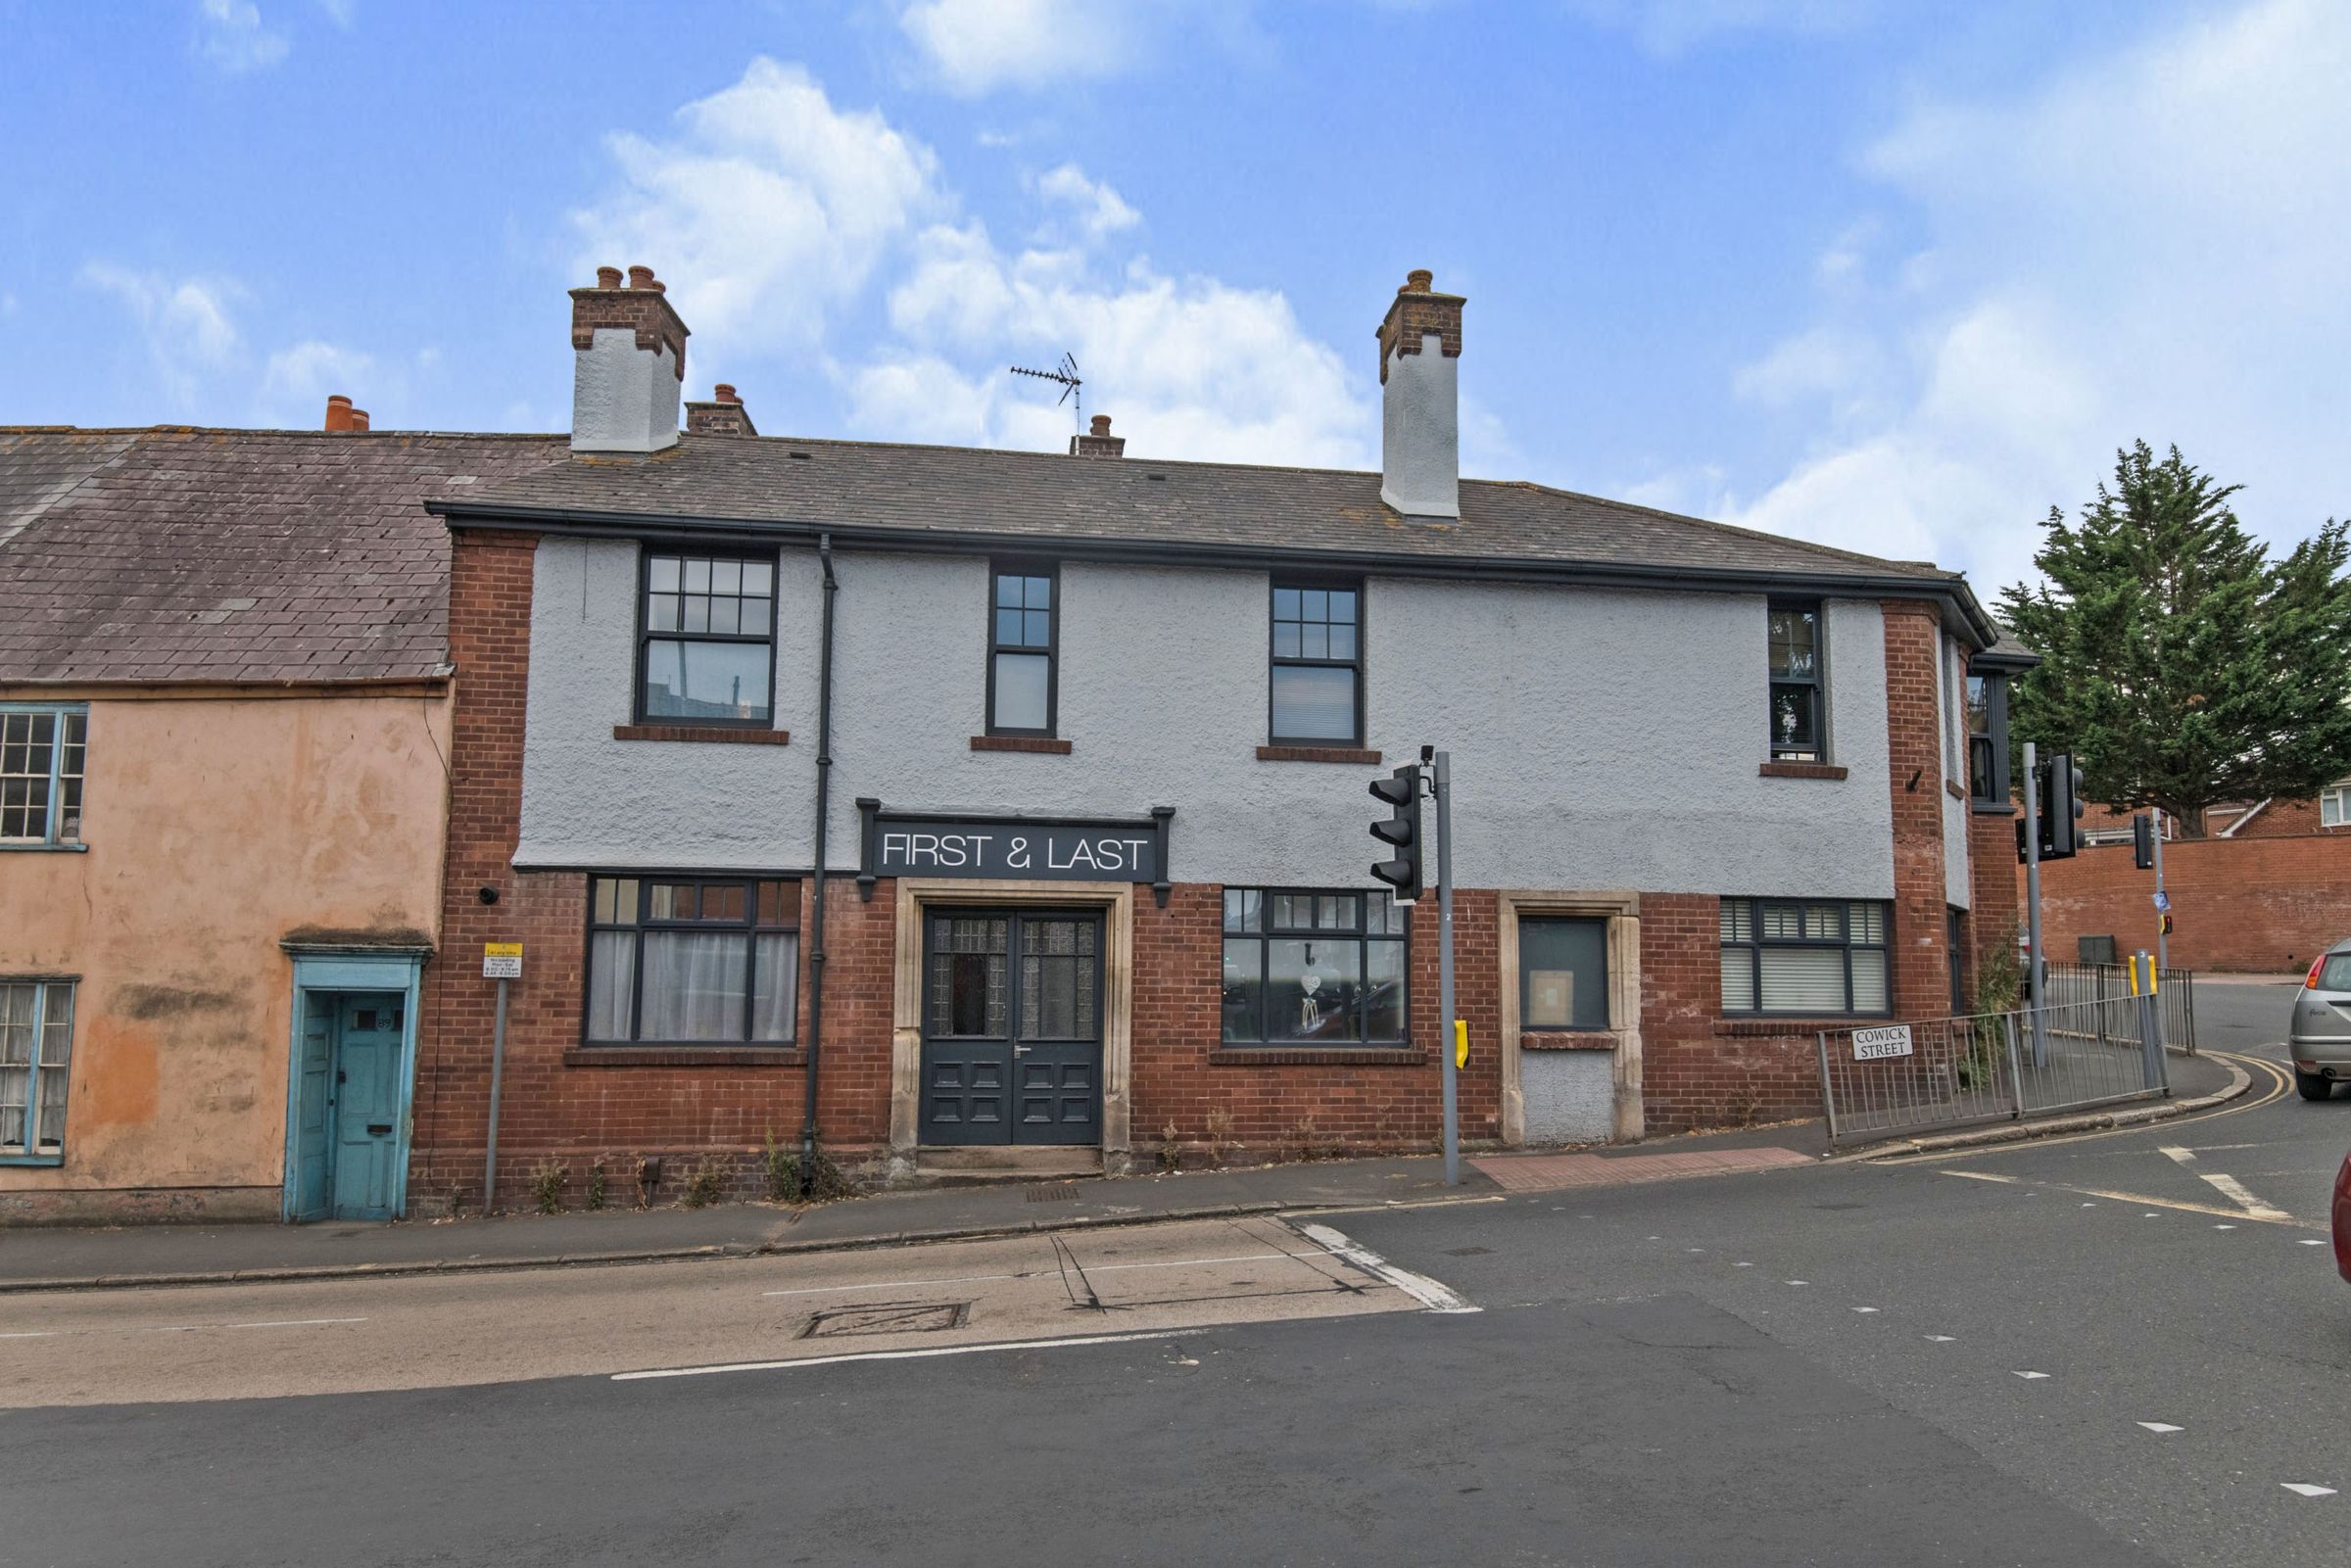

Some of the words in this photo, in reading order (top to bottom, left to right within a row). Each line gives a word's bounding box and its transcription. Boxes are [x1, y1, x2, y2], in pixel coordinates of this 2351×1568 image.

[883, 833, 993, 867] FIRST
[1006, 836, 1031, 869] &
[1047, 837, 1149, 871] LAST
[378, 1019, 392, 1028] 89
[1856, 1027, 1906, 1043] COWICK
[1861, 1042, 1905, 1058] STREET
